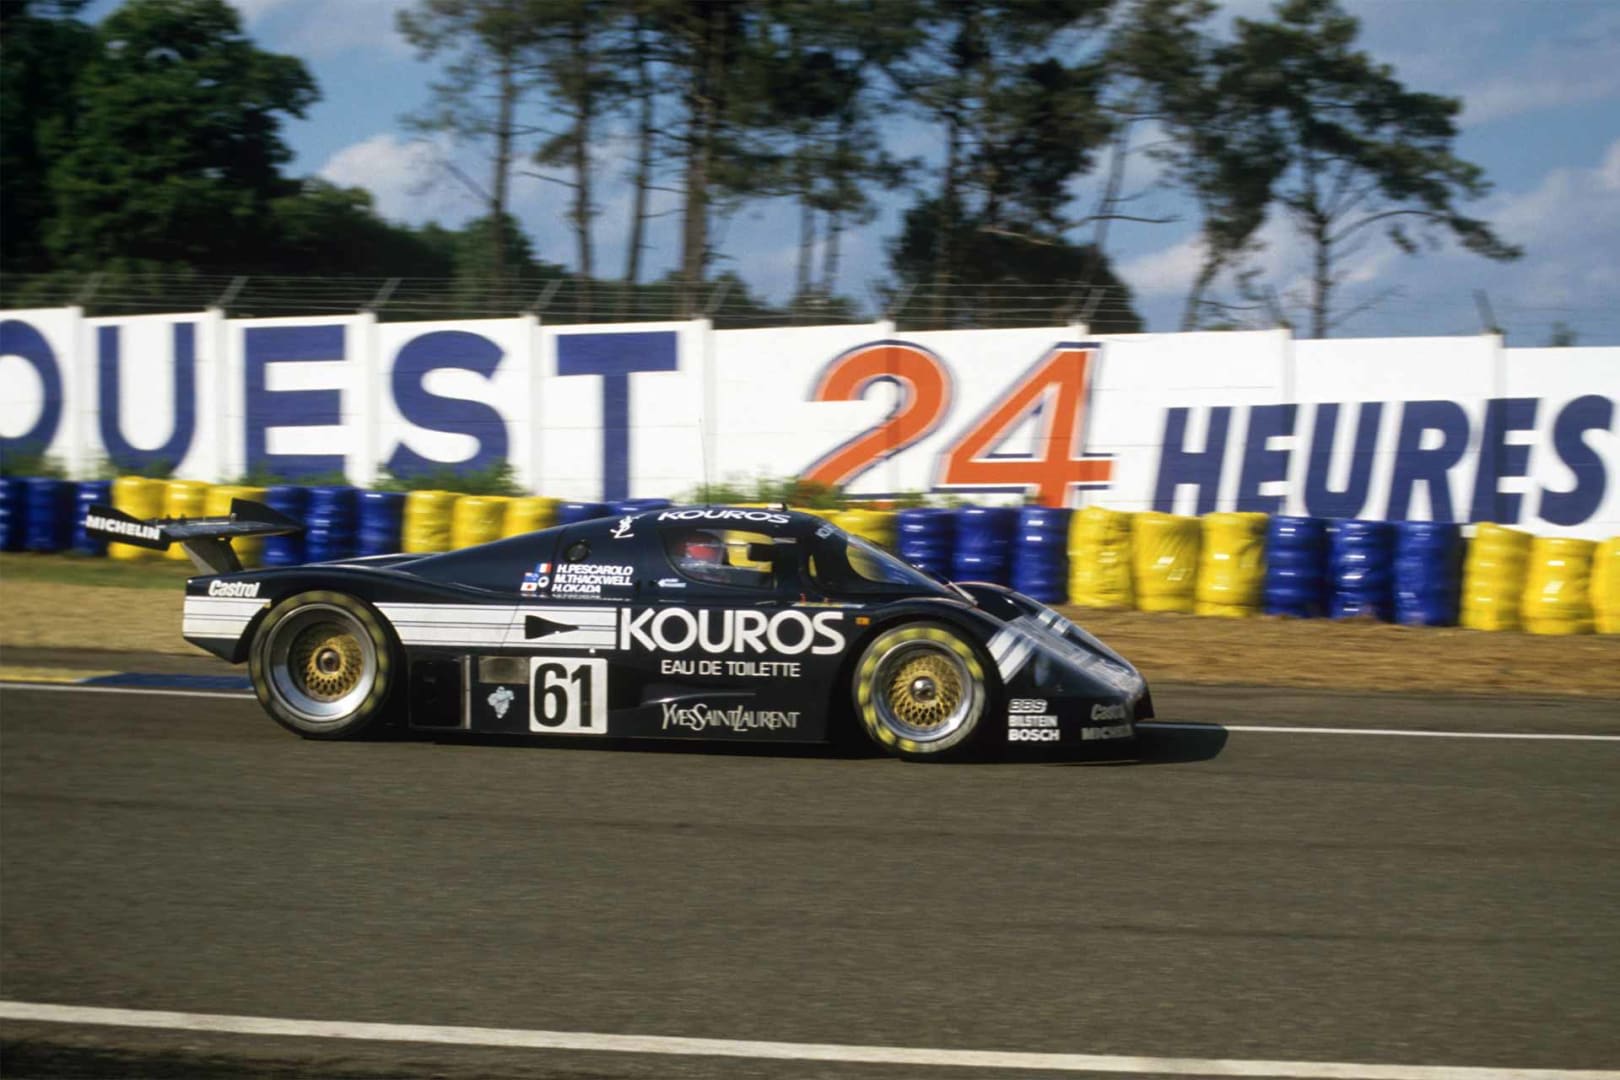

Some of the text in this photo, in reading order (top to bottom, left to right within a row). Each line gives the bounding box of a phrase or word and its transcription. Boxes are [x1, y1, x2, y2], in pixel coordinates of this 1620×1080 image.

[0, 318, 679, 500] OUEST
[802, 340, 1615, 526] 24 HEURES
[657, 509, 792, 524] KOUROS
[85, 514, 161, 540] MICHELIN
[208, 580, 260, 598] Castrol
[551, 583, 601, 593] H.OKADA
[620, 607, 846, 655] KOUROS
[661, 660, 801, 677] EAU DE TOILETTE
[533, 662, 593, 728] 61
[1008, 698, 1049, 713] BBS
[1008, 729, 1060, 741] BOSCH
